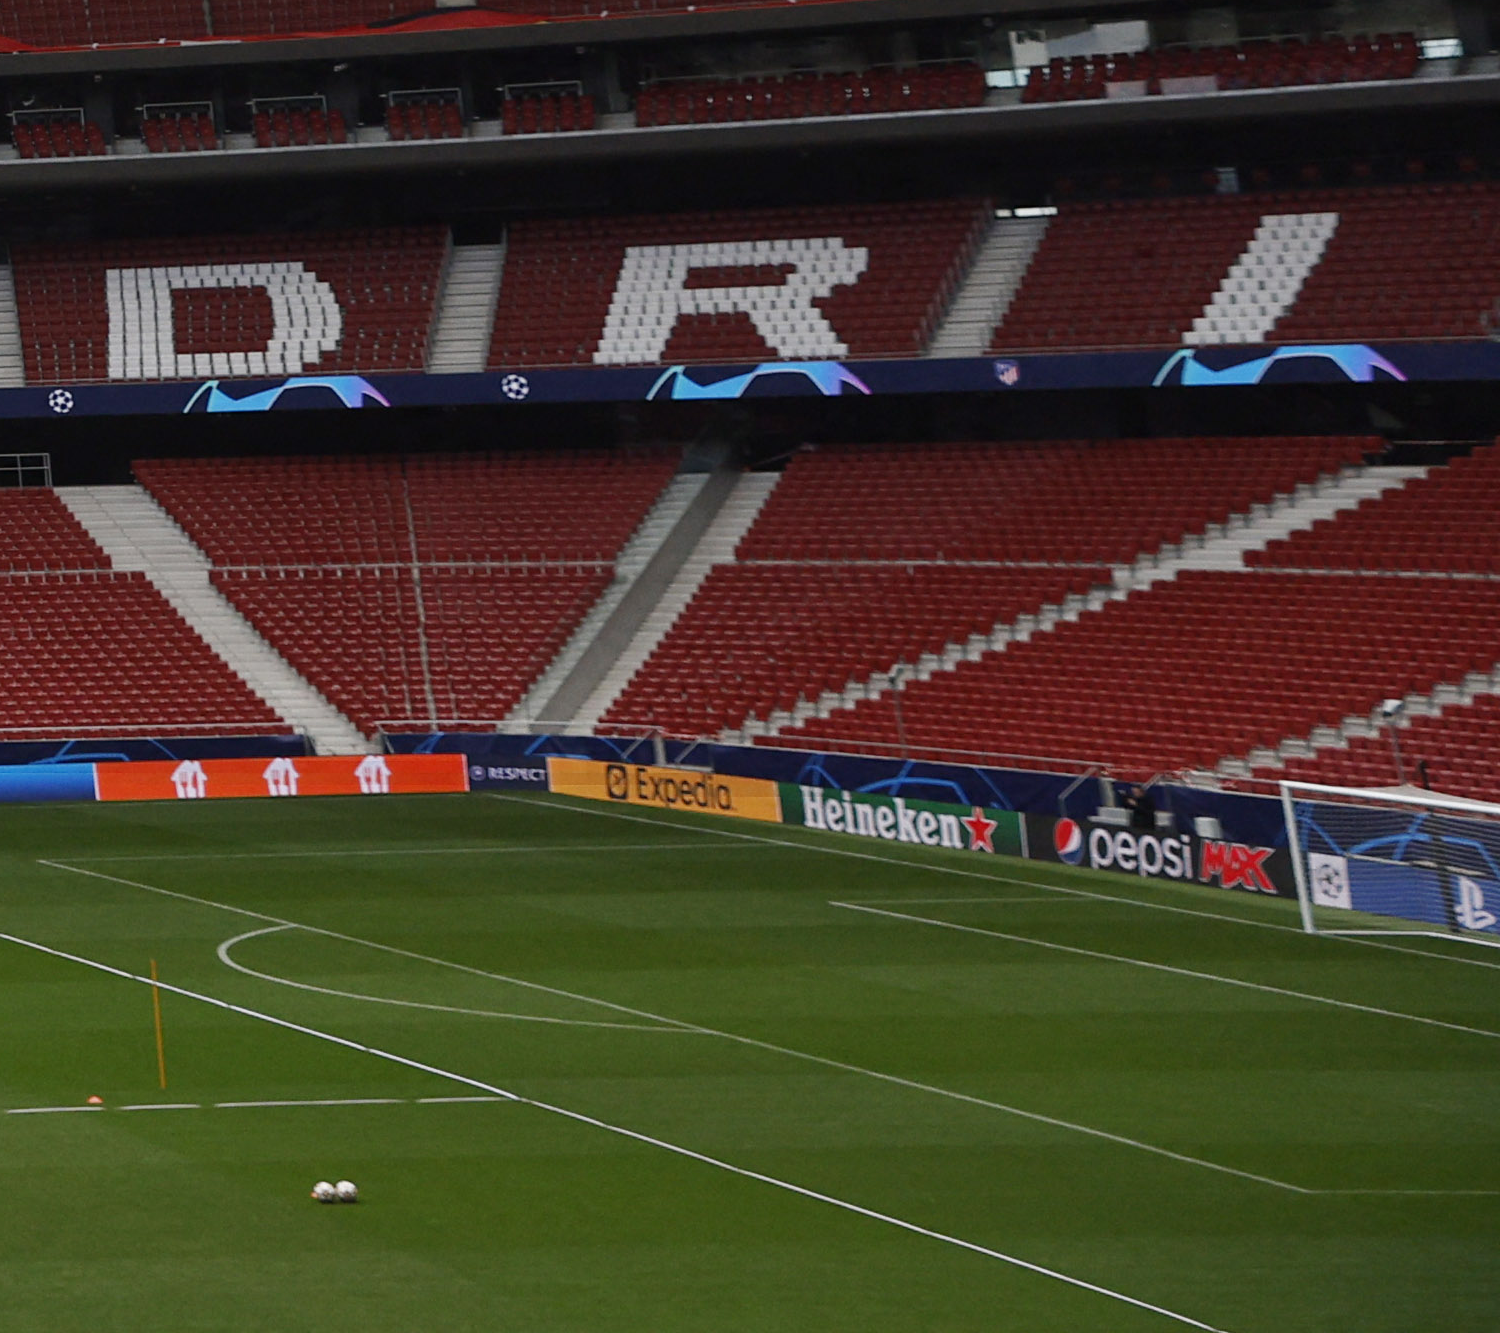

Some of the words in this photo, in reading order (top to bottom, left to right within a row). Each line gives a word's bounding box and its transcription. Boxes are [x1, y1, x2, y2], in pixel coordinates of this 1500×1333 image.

[488, 766, 547, 781] RESPECT
[635, 768, 732, 811] Expedia
[800, 785, 964, 849] Heineken
[1089, 827, 1193, 878] pepsi
[1199, 839, 1277, 894] MAX
